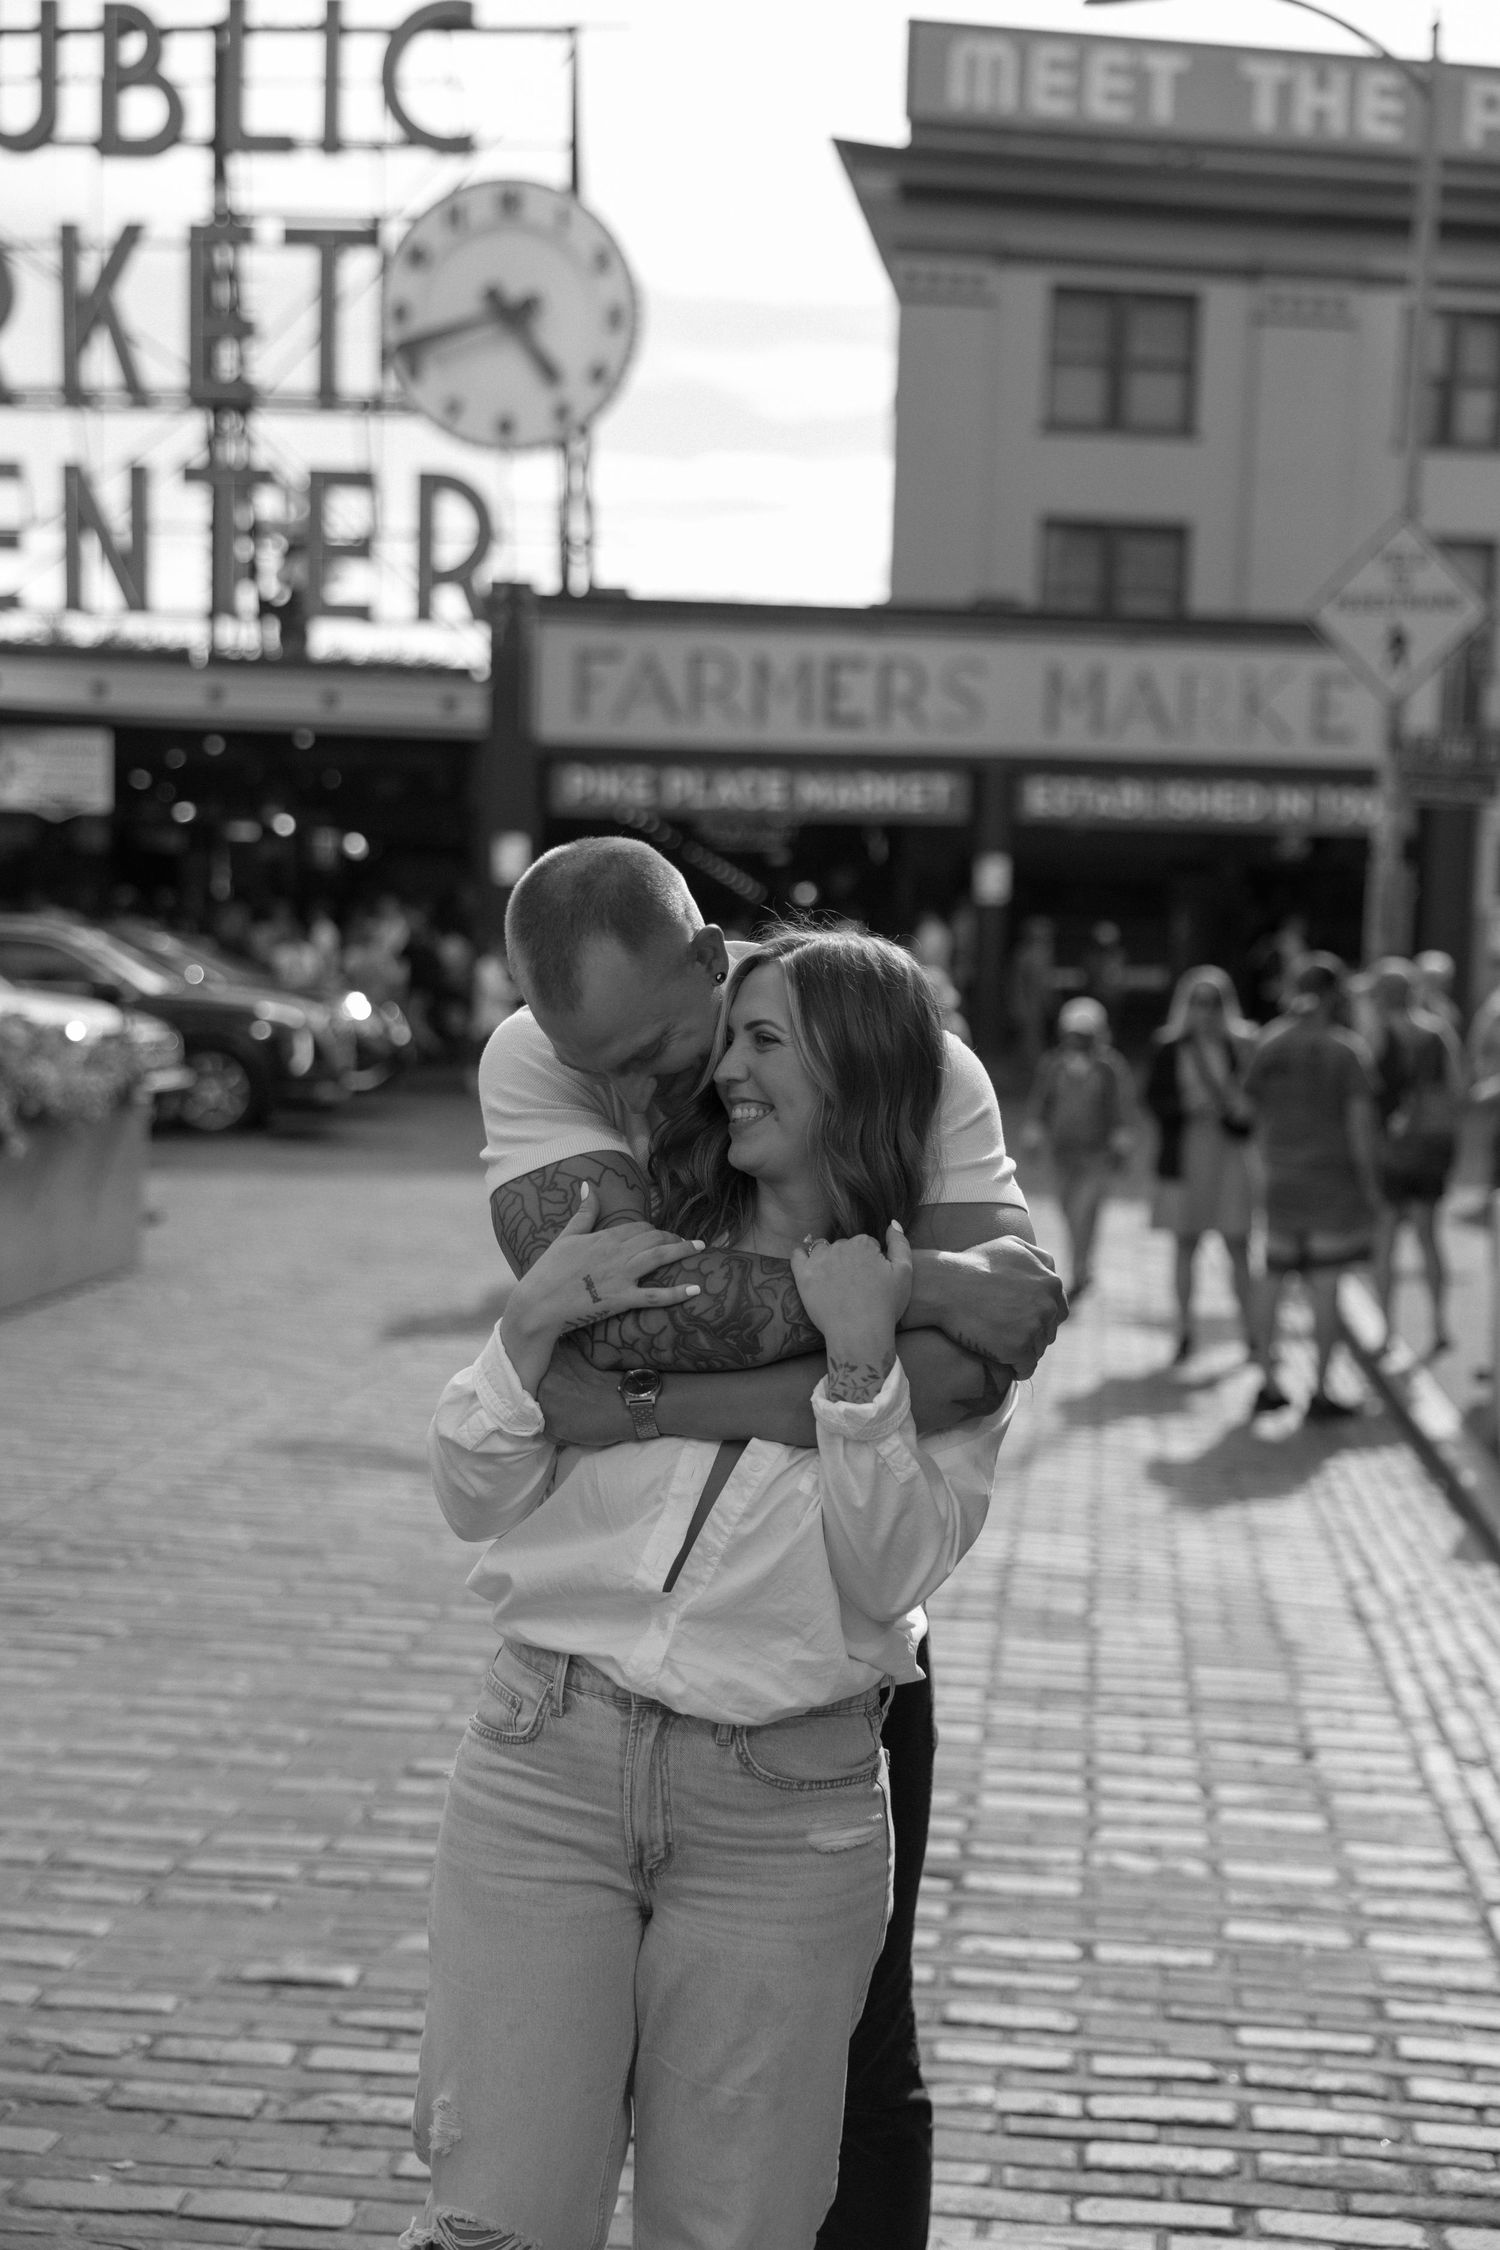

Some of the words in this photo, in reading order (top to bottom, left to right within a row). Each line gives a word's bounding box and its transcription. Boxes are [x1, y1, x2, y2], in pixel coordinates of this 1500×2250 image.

[943, 34, 1194, 128] MEET
[1235, 54, 1408, 144] THE
[0, 224, 380, 406] KET
[569, 640, 992, 735] FARMERS
[562, 763, 660, 808] PIKE
[662, 766, 790, 811] PLACE
[792, 769, 956, 814] MARKET
